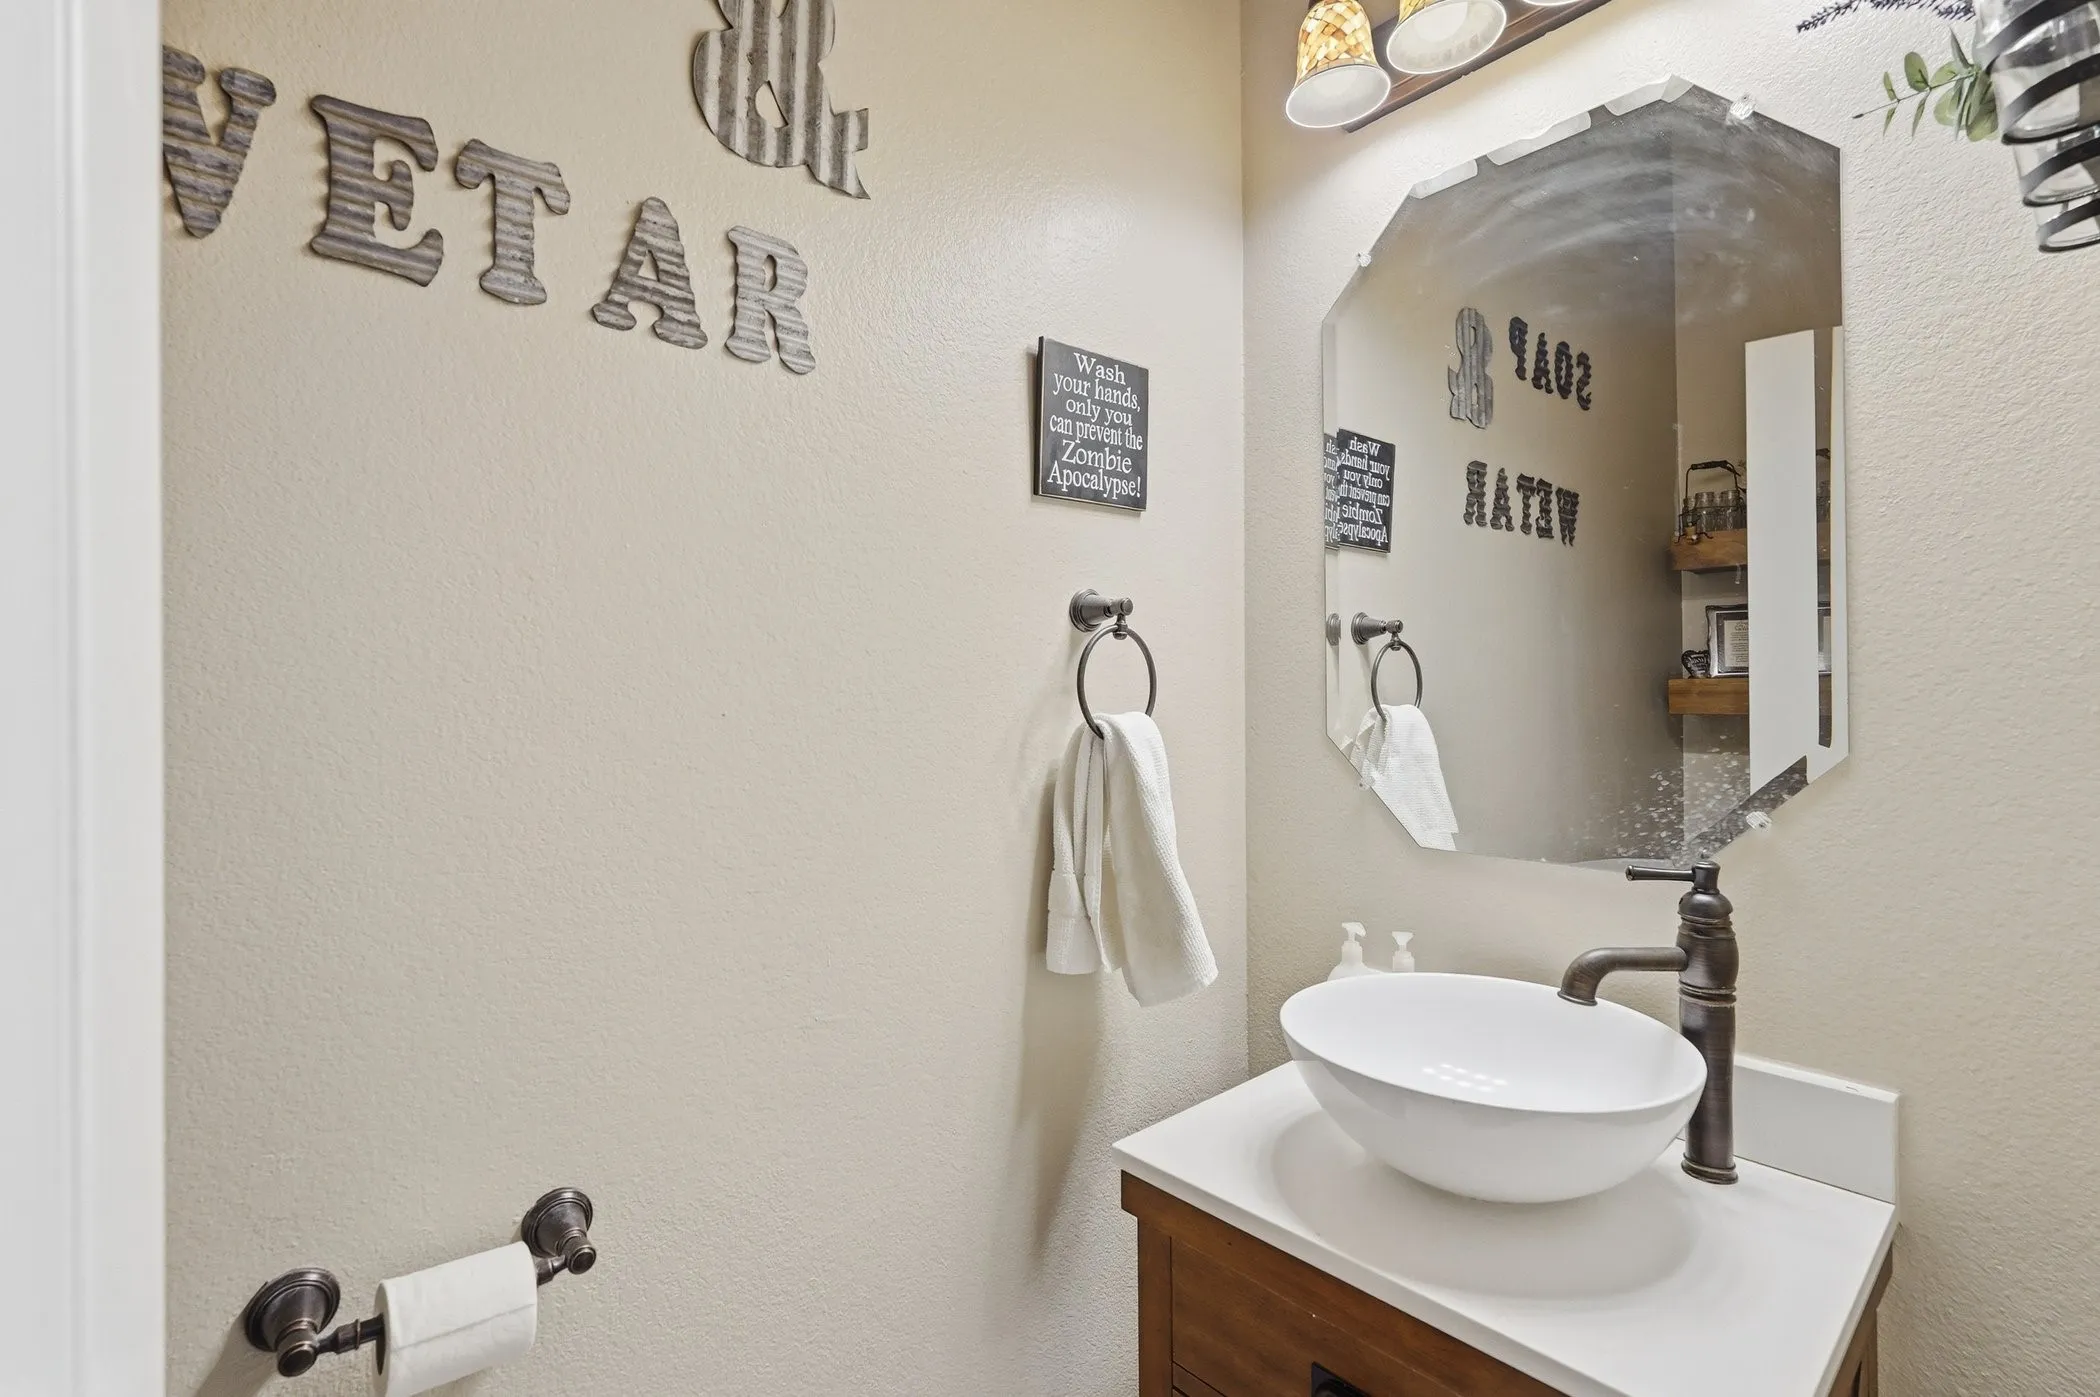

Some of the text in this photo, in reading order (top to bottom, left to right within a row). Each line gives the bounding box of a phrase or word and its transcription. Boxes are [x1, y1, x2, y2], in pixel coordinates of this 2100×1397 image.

[1073, 352, 1126, 385] Wash
[1053, 372, 1141, 412] your hands,
[1065, 398, 1133, 426] only you
[1049, 414, 1143, 450] can prevent the
[1061, 439, 1132, 474] Zombie
[1047, 459, 1141, 500] Apocalypse!
